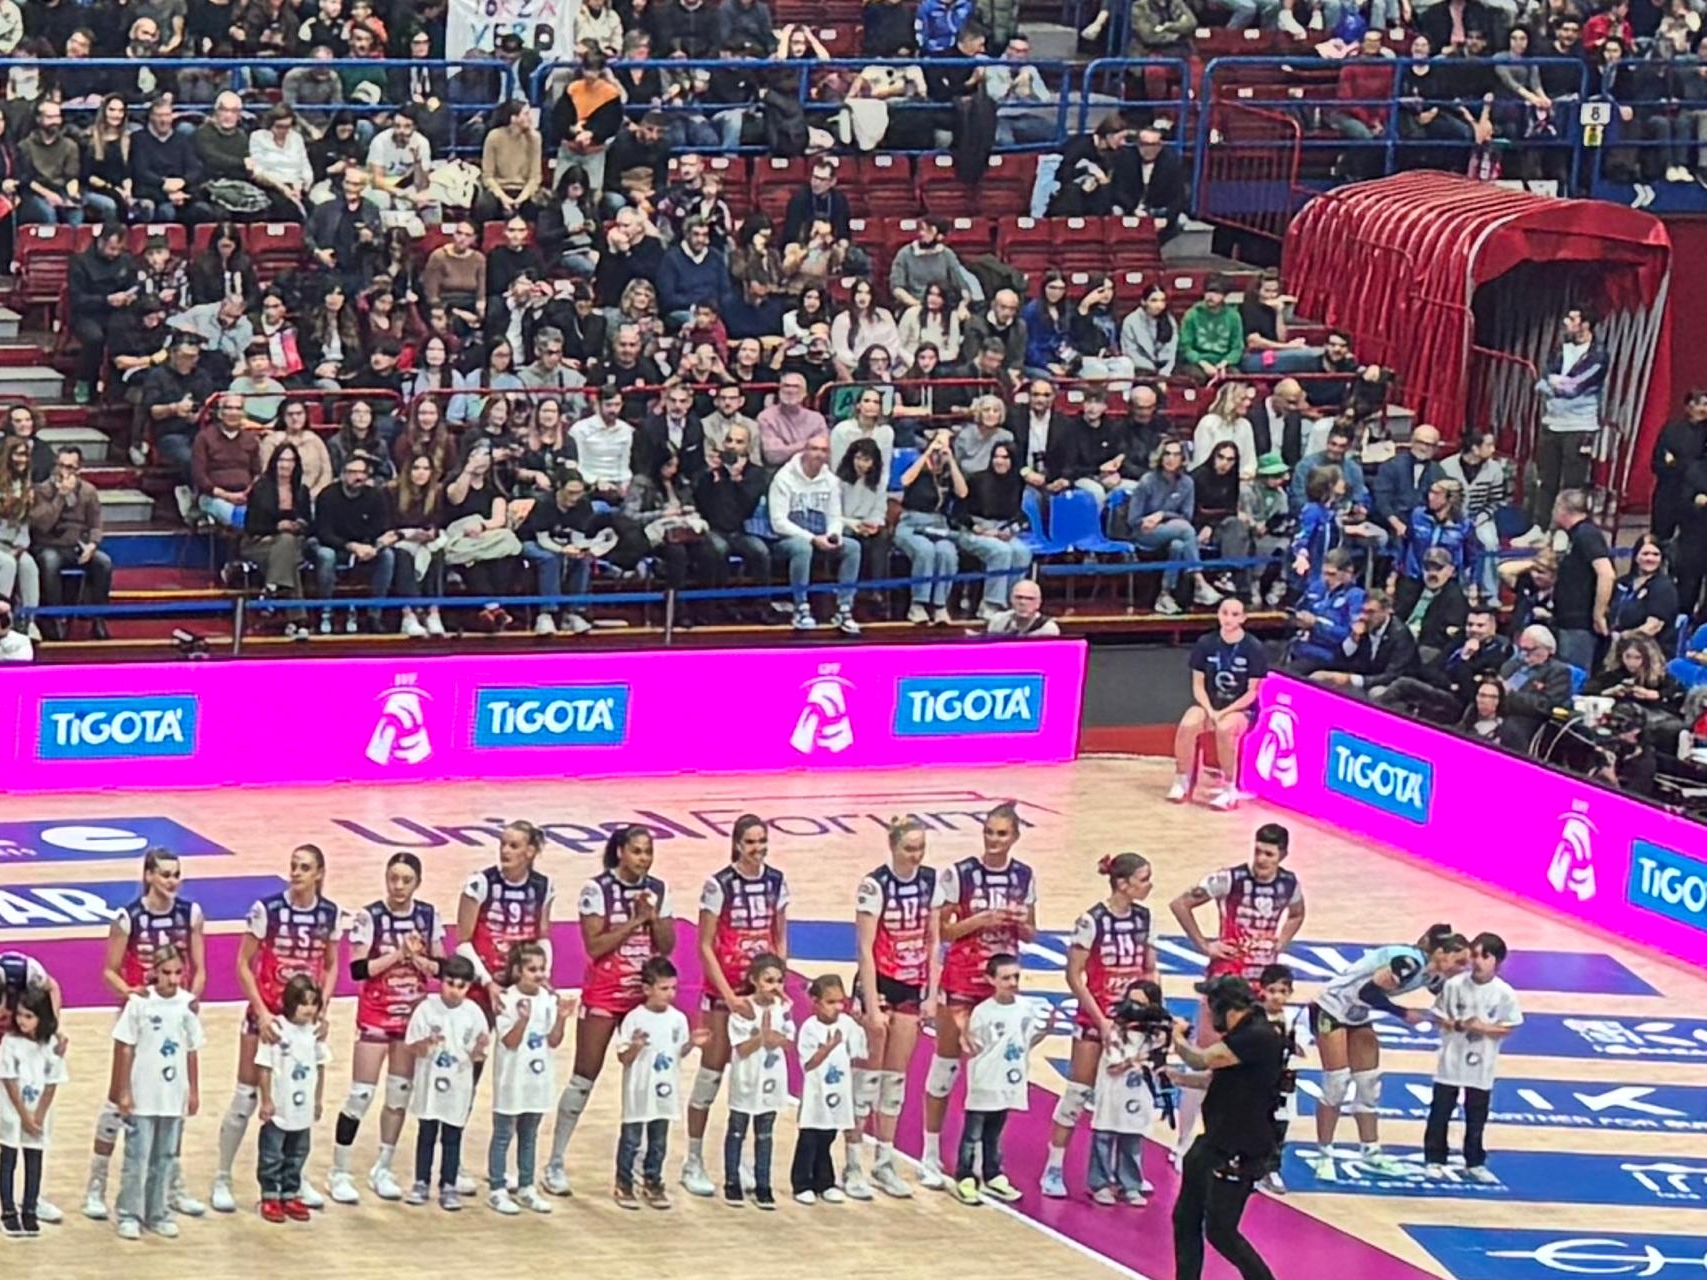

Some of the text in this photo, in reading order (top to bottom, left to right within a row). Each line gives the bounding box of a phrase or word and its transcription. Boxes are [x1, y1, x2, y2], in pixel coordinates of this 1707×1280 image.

[1590, 106, 1601, 122] 8
[508, 903, 522, 923] 9
[903, 896, 920, 921] 17
[298, 926, 311, 948] 5
